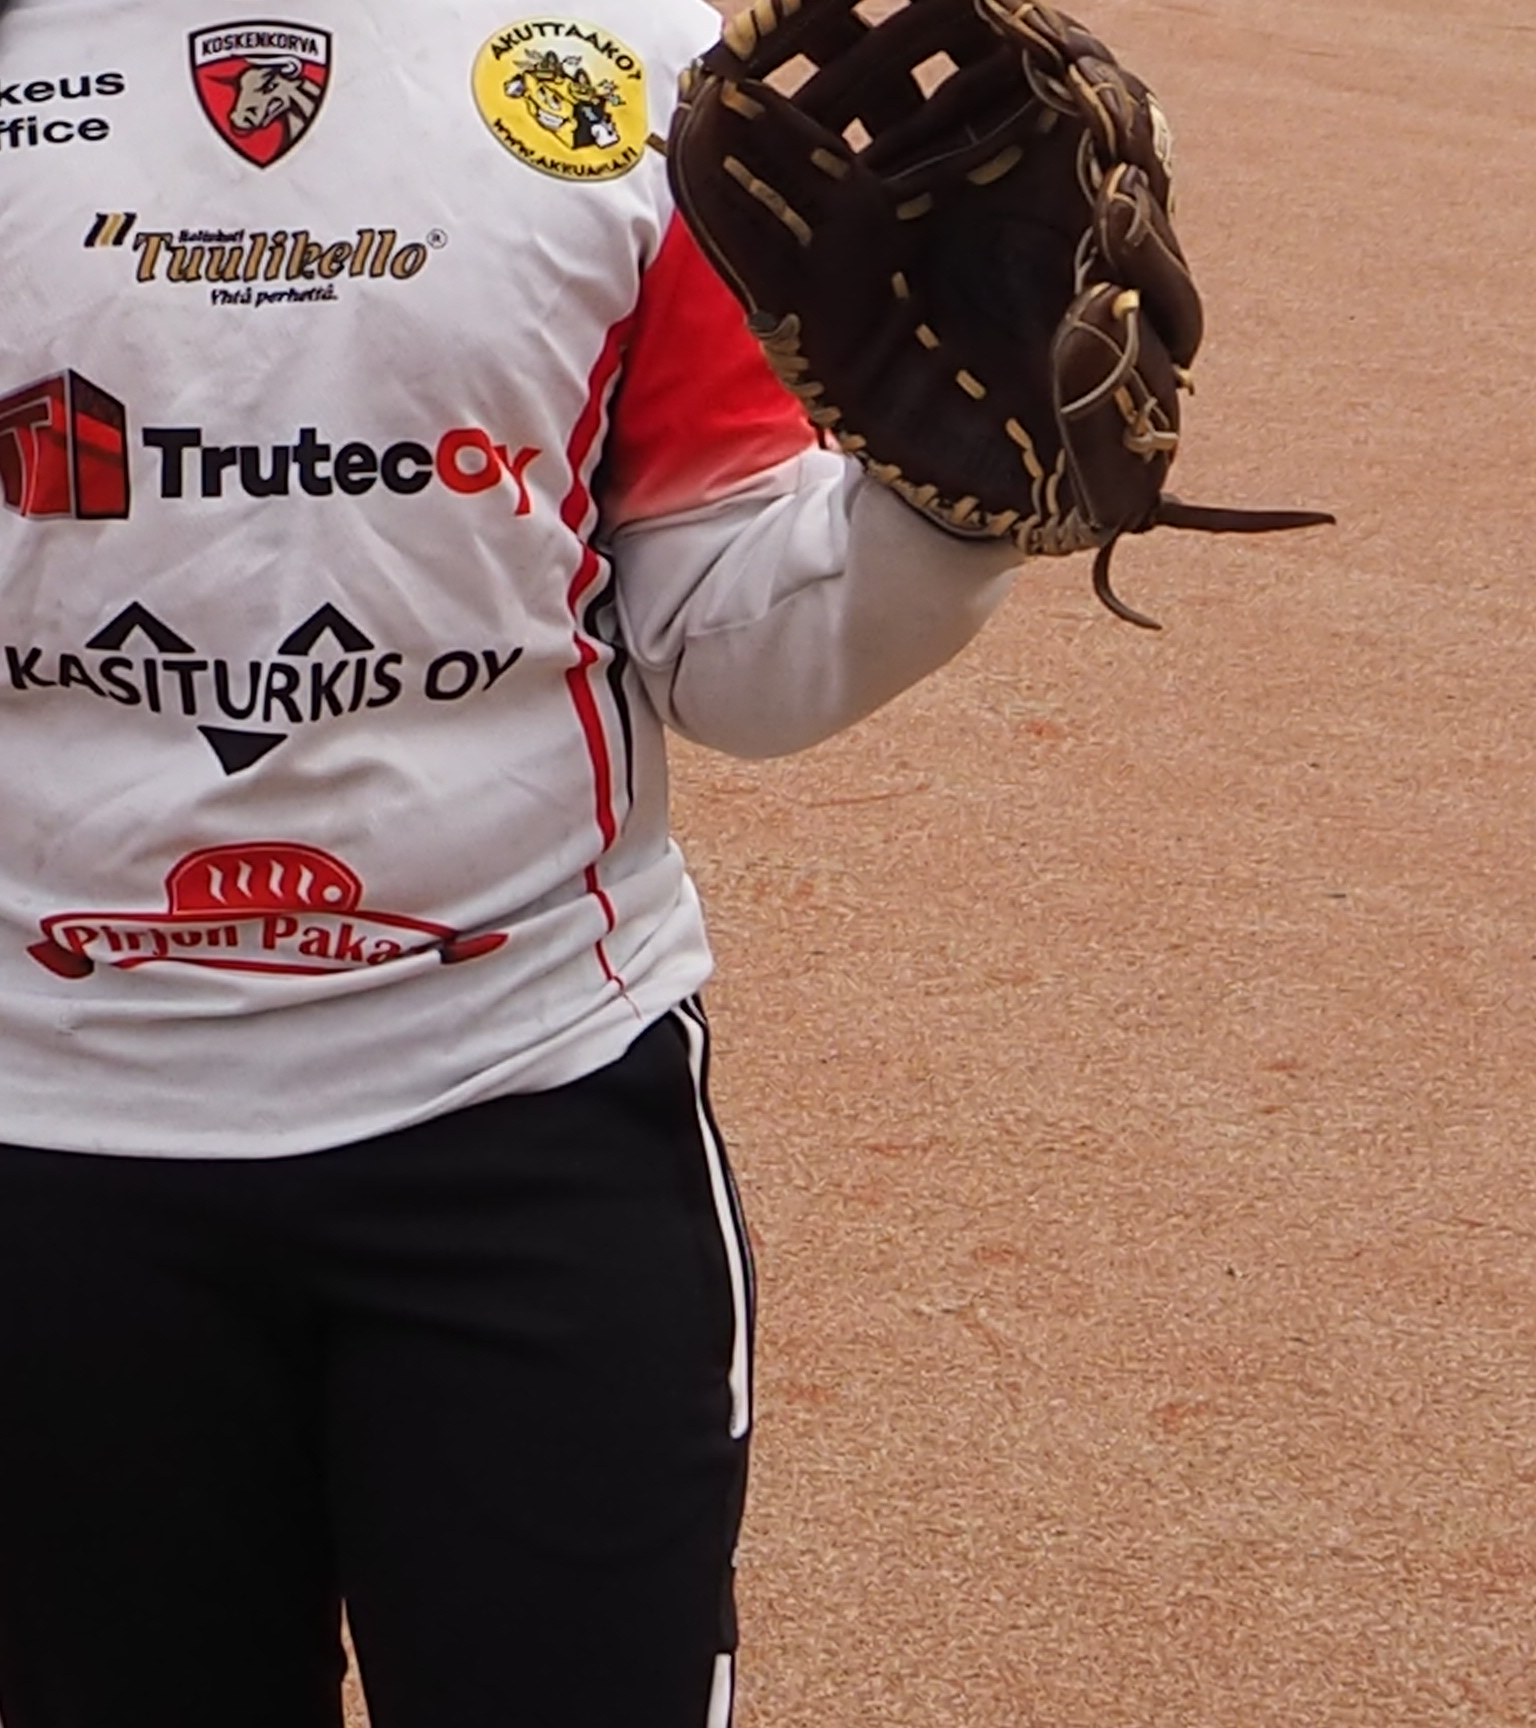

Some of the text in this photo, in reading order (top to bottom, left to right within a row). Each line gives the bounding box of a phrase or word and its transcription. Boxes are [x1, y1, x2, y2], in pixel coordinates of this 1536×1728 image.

[202, 33, 319, 56] KOSKENKORVA
[132, 229, 427, 284] Tuulikello
[4, 646, 523, 723] KASITURKIS OY
[261, 916, 433, 966] Paka
